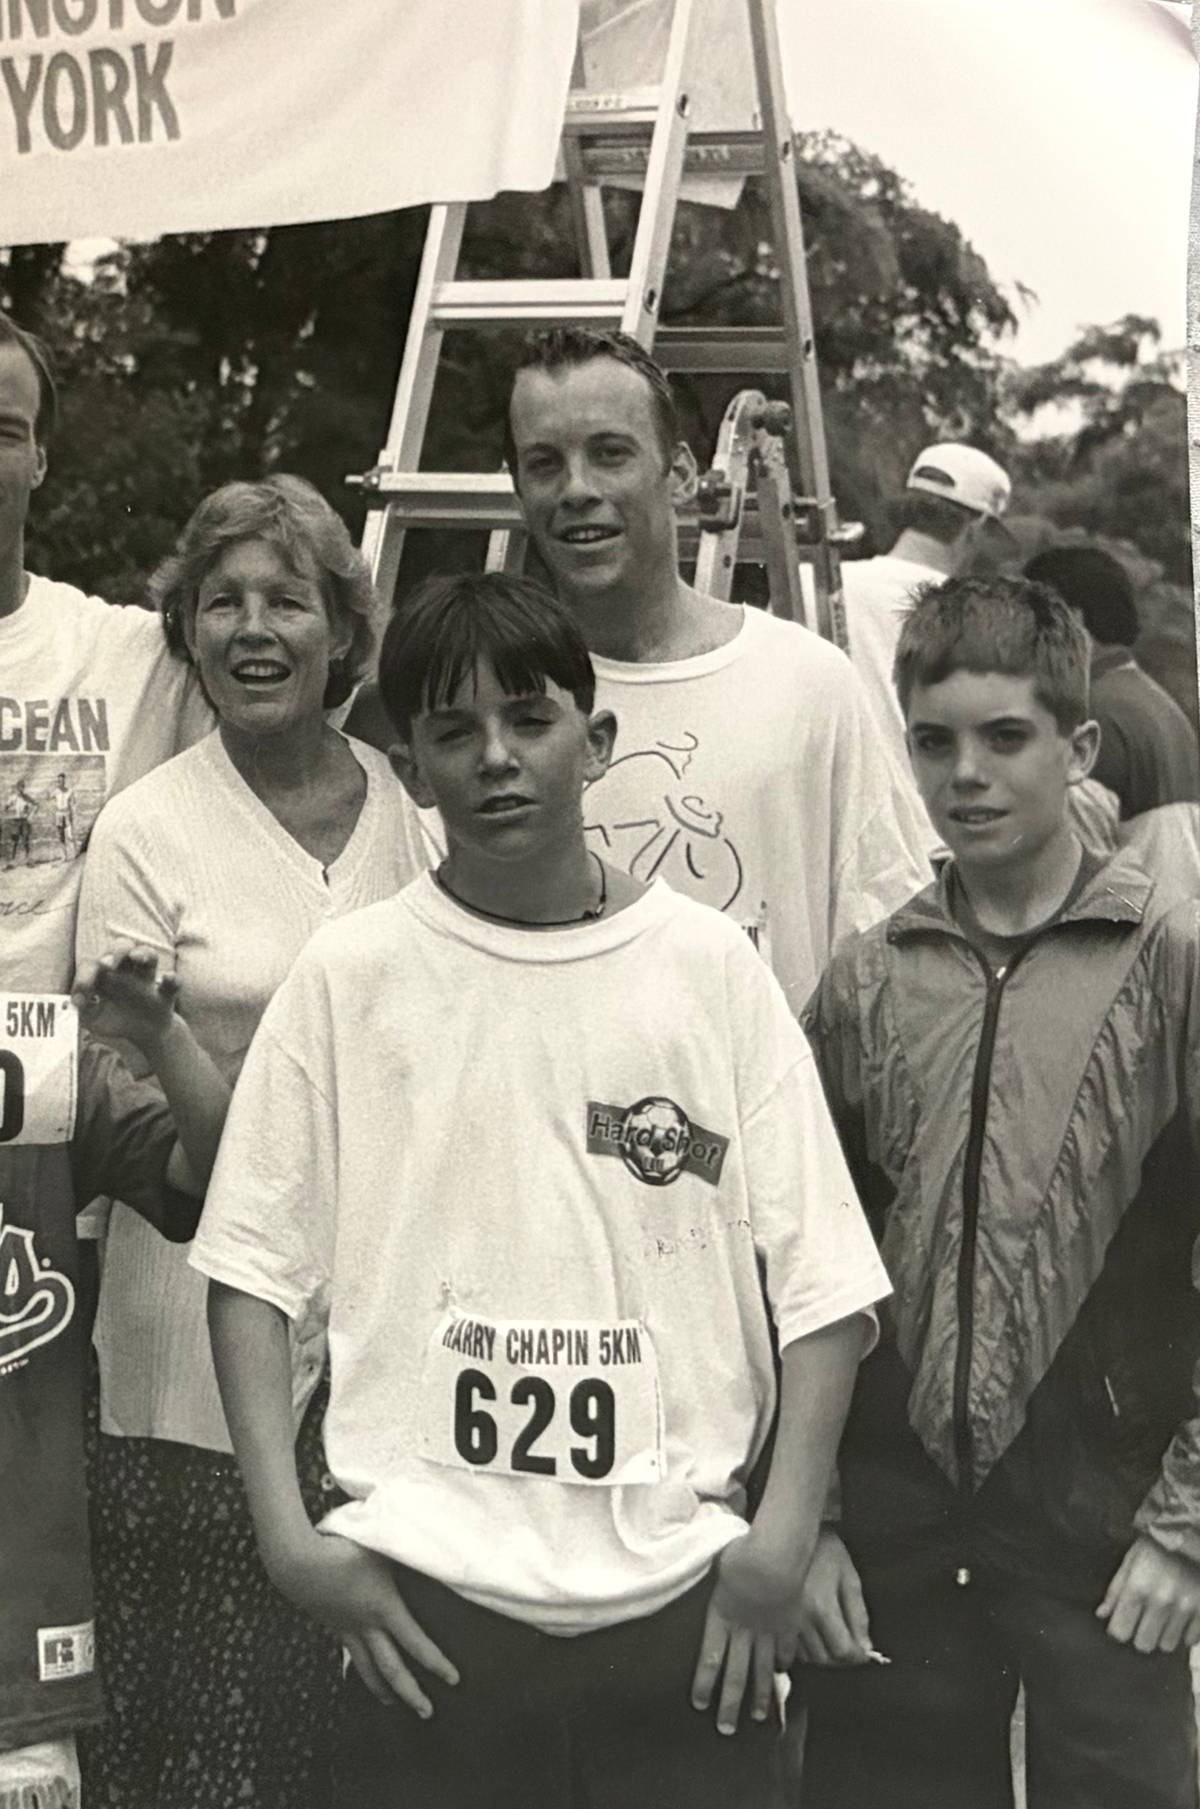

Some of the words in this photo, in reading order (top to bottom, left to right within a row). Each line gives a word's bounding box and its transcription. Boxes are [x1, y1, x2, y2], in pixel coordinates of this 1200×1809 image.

[1, 41, 181, 154] YORK
[5, 1001, 56, 1037] 5KM
[590, 1112, 657, 1147] Hard
[662, 1126, 720, 1165] Shot
[442, 1318, 497, 1362] HARRY
[506, 1328, 589, 1365] CHAPIN
[600, 1327, 642, 1365] 5KM
[453, 1368, 616, 1480] 629
